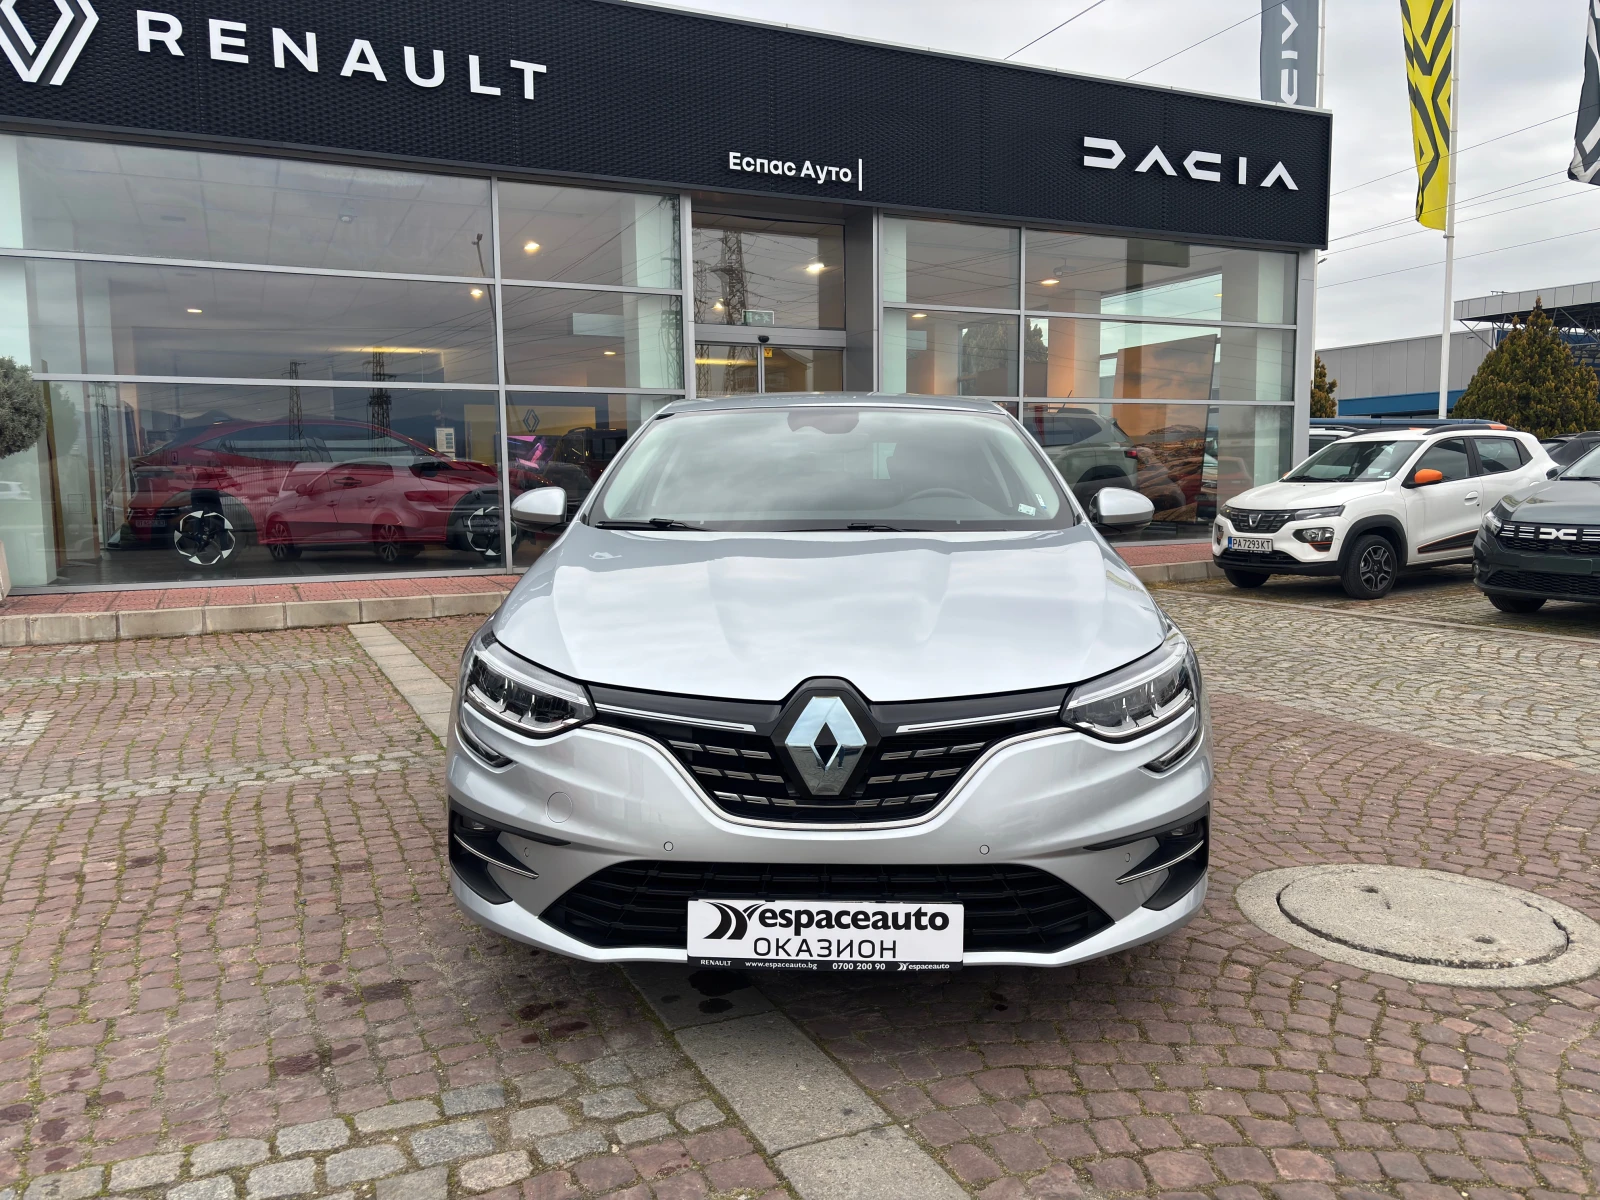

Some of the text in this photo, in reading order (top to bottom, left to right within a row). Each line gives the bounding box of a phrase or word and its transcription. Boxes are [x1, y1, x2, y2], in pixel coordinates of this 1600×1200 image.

[137, 10, 547, 100] RENAULT
[729, 151, 852, 184] Еспас Ауто
[1084, 136, 1299, 191] DACIA
[758, 906, 950, 936] espaceauto
[753, 937, 897, 959] ОКАЗИОН
[700, 959, 950, 971] RENAULT www.espaceauto.bg 0700 200 90 espaceauto
